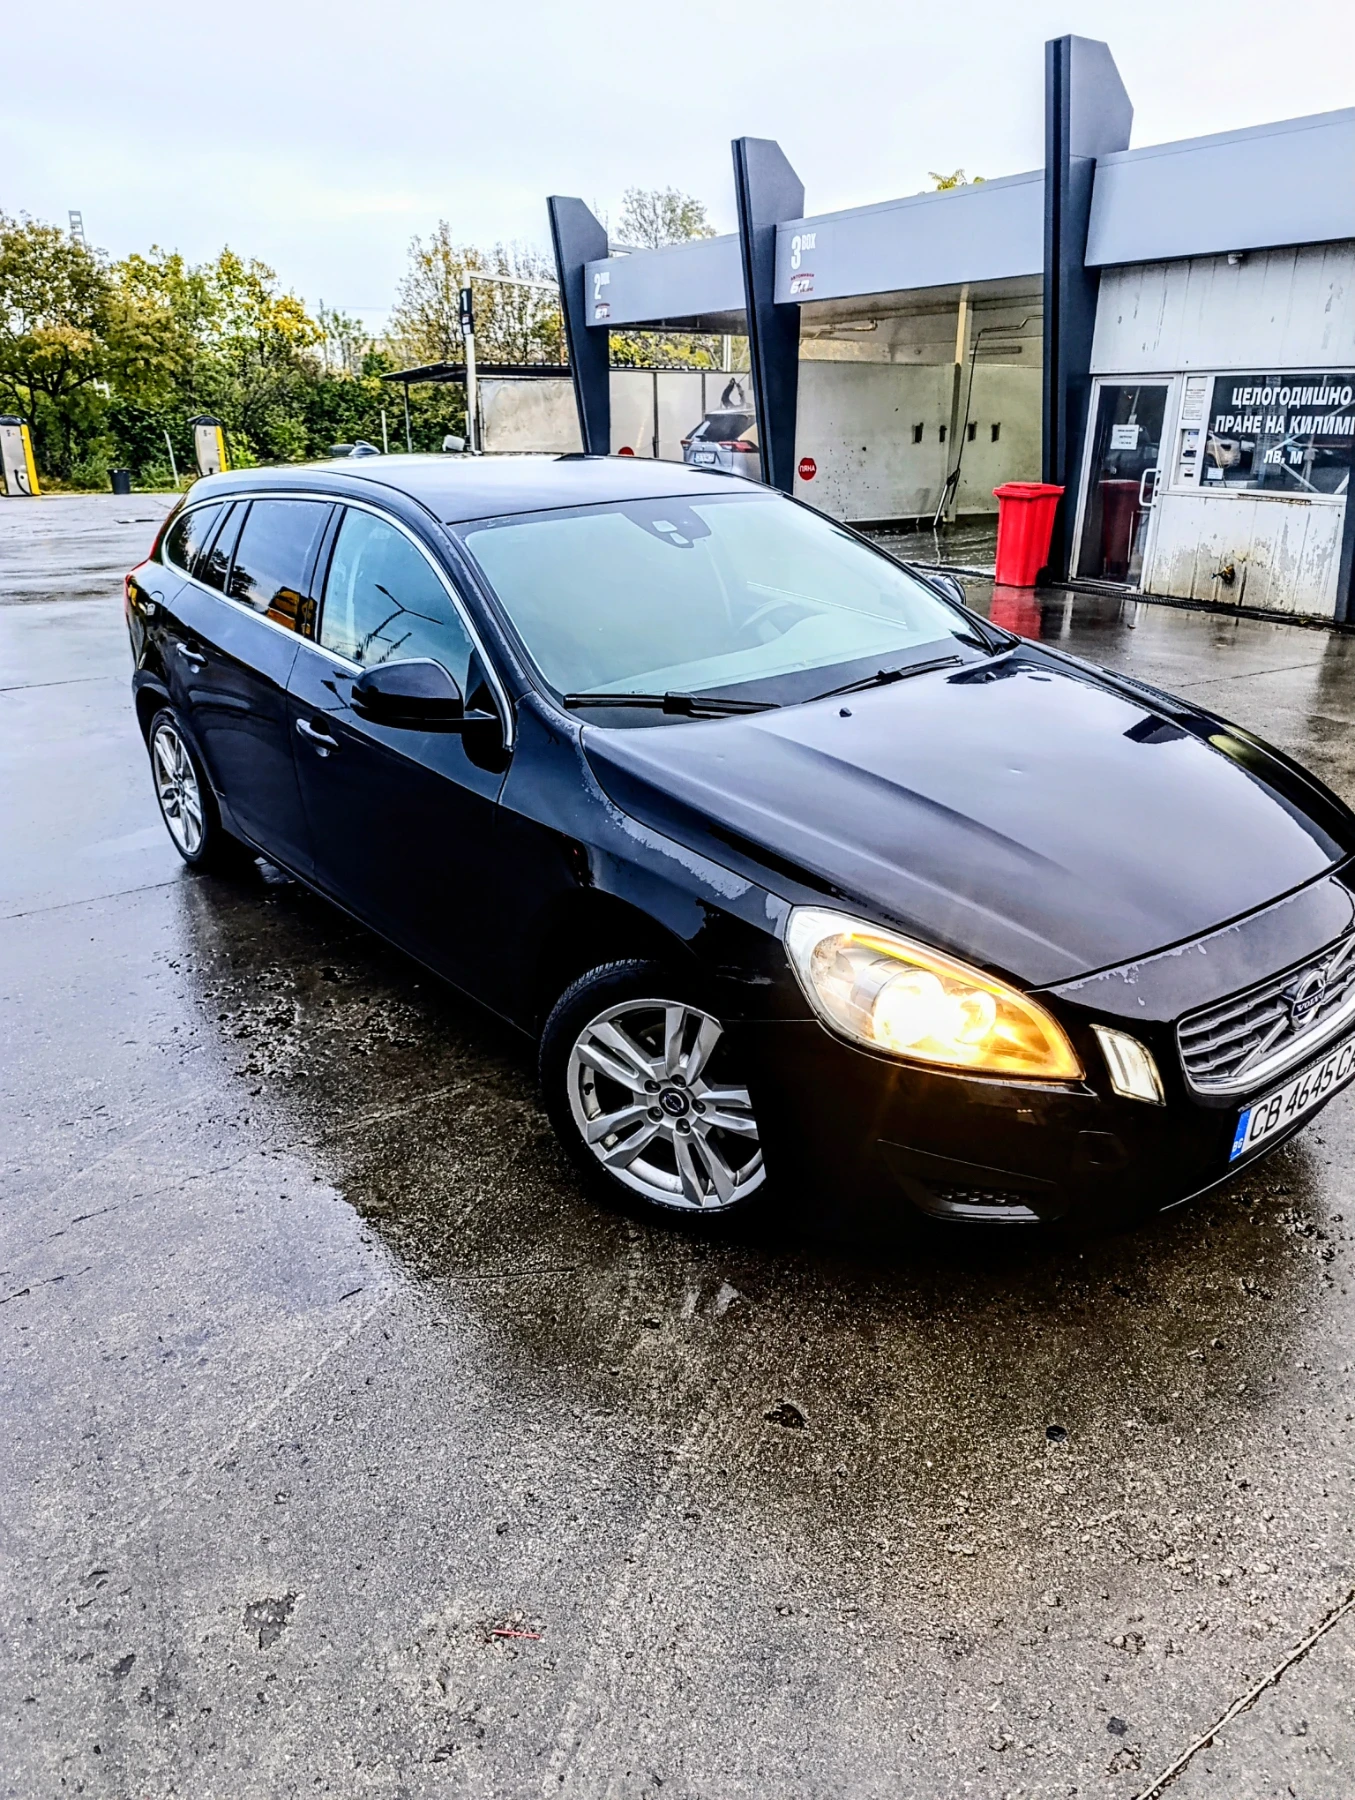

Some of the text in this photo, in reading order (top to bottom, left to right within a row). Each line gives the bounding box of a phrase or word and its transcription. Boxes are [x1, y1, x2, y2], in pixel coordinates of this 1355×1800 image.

[791, 233, 817, 270] 3 BOX
[594, 273, 601, 300] 2
[461, 291, 468, 311] 1
[1231, 385, 1353, 409] ЦЕЛОГОДИШНО
[1214, 415, 1262, 433] ПРАНЕ
[1264, 416, 1285, 434] НА
[800, 465, 816, 473] ПЯНА
[1249, 1094, 1283, 1142] CB
[1284, 1056, 1337, 1116] 4645
